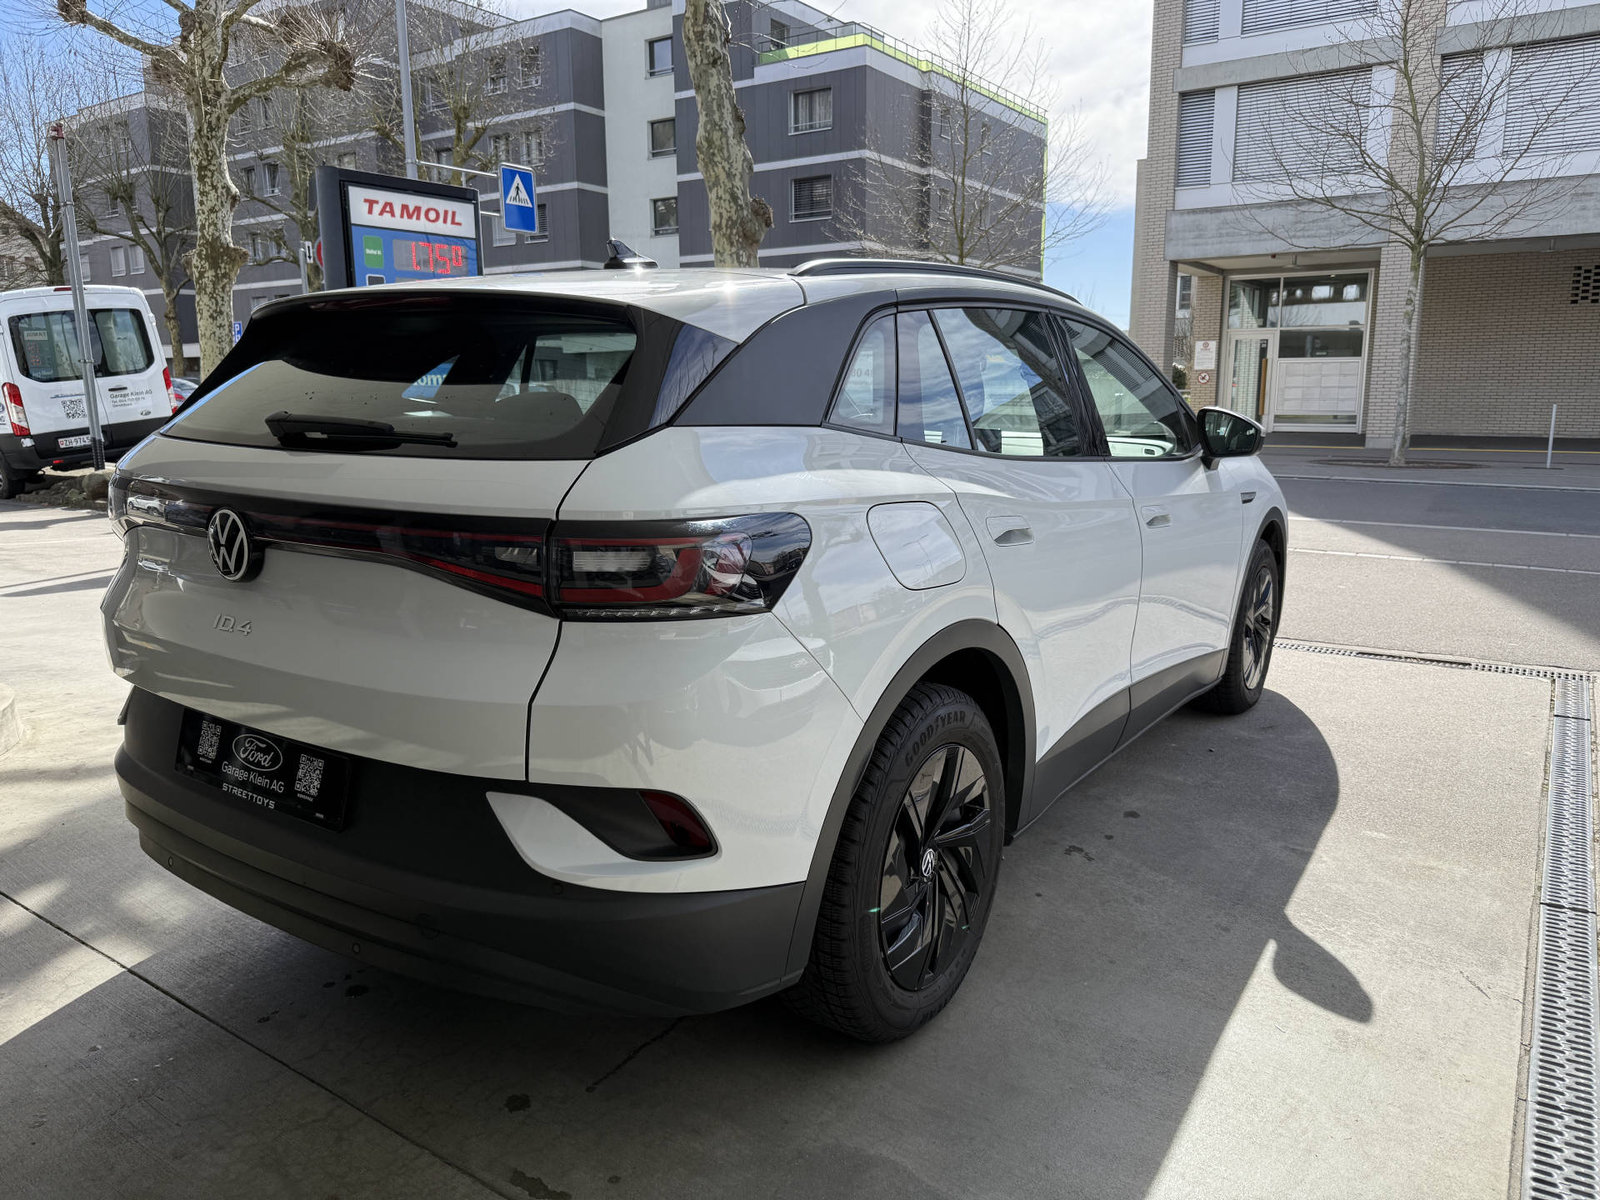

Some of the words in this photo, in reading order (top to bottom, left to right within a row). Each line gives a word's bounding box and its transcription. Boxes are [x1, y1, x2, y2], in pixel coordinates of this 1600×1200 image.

[363, 198, 463, 226] TAMOIL
[240, 737, 274, 767] Ford
[905, 710, 966, 767] GOODYEAR
[221, 761, 249, 781] Garage
[249, 772, 270, 789] Klein
[270, 780, 285, 793] AG
[222, 783, 276, 809] STREETTOYS
